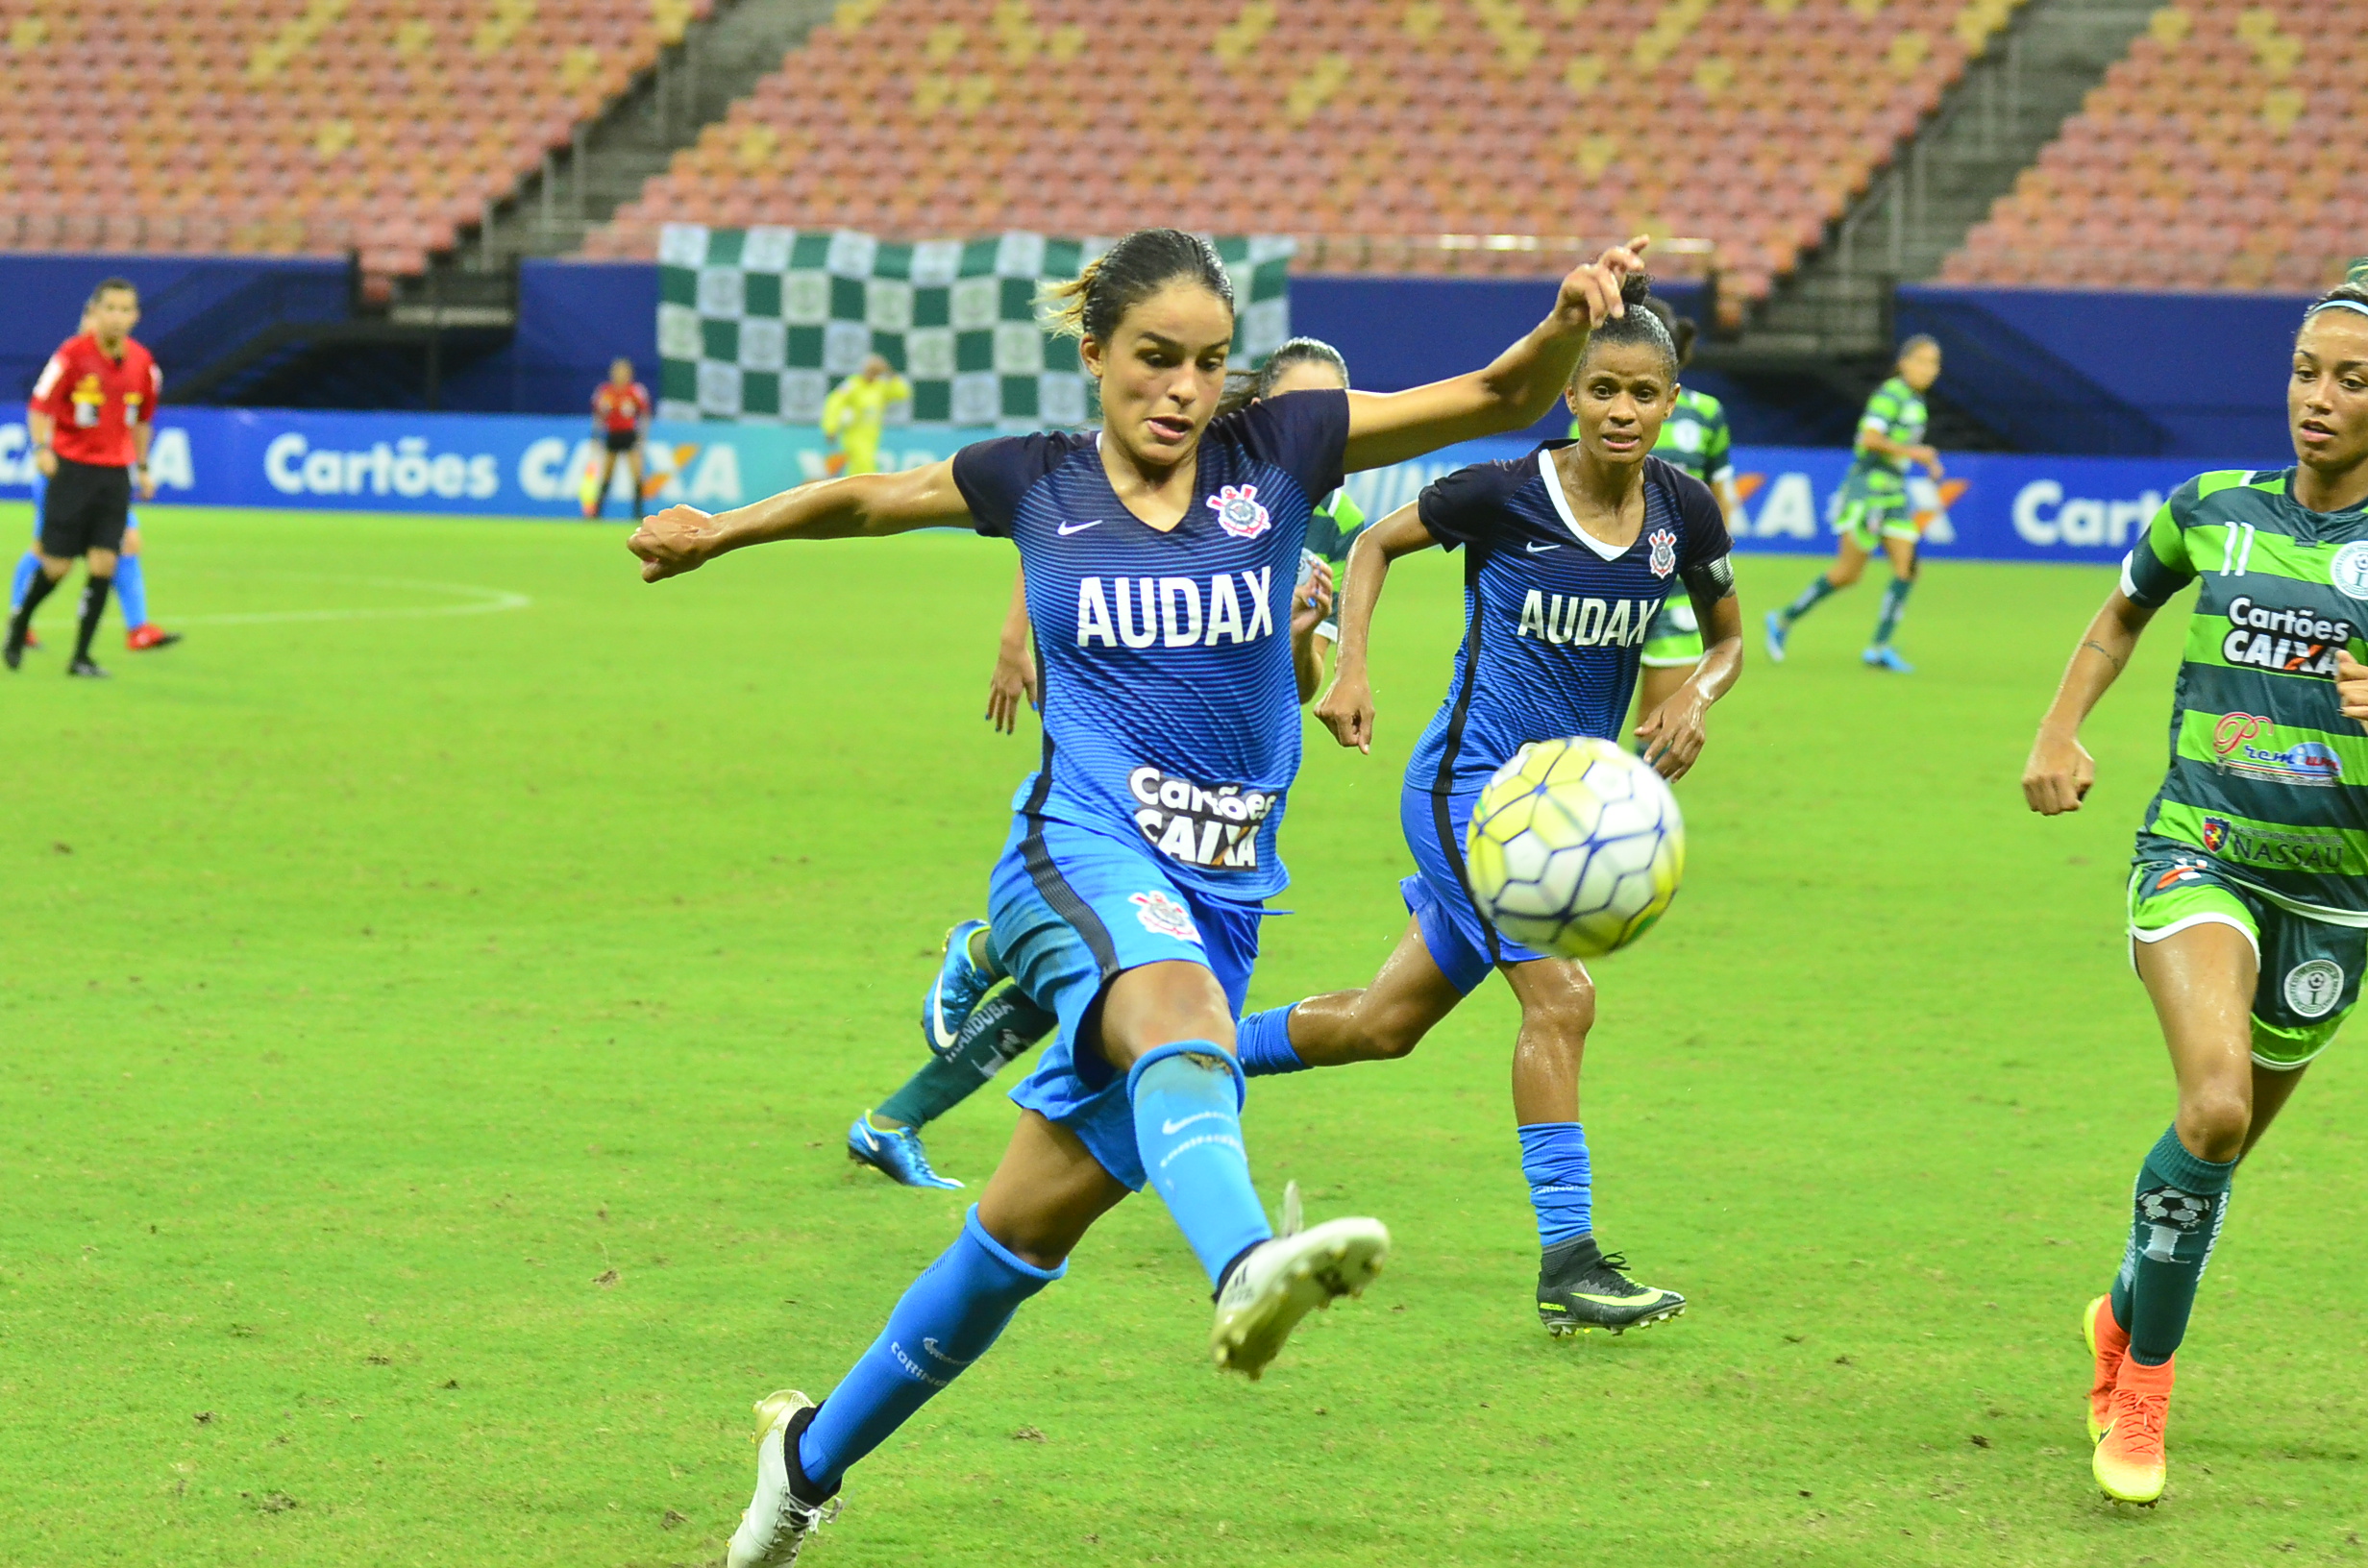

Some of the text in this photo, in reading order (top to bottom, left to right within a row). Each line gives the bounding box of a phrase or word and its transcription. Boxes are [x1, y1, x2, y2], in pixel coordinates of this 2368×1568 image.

[264, 432, 498, 500] Cartões
[2011, 479, 2168, 547] Cart
[2220, 521, 2256, 576] 11
[1077, 566, 1272, 649] AUDAX
[1517, 589, 1660, 648] AUDAX
[2229, 597, 2350, 643] Cartões
[2223, 629, 2338, 676] CAIXA
[2213, 712, 2340, 771] Premium
[1134, 809, 1260, 867] CAIXA
[2232, 834, 2343, 868] NASSAU
